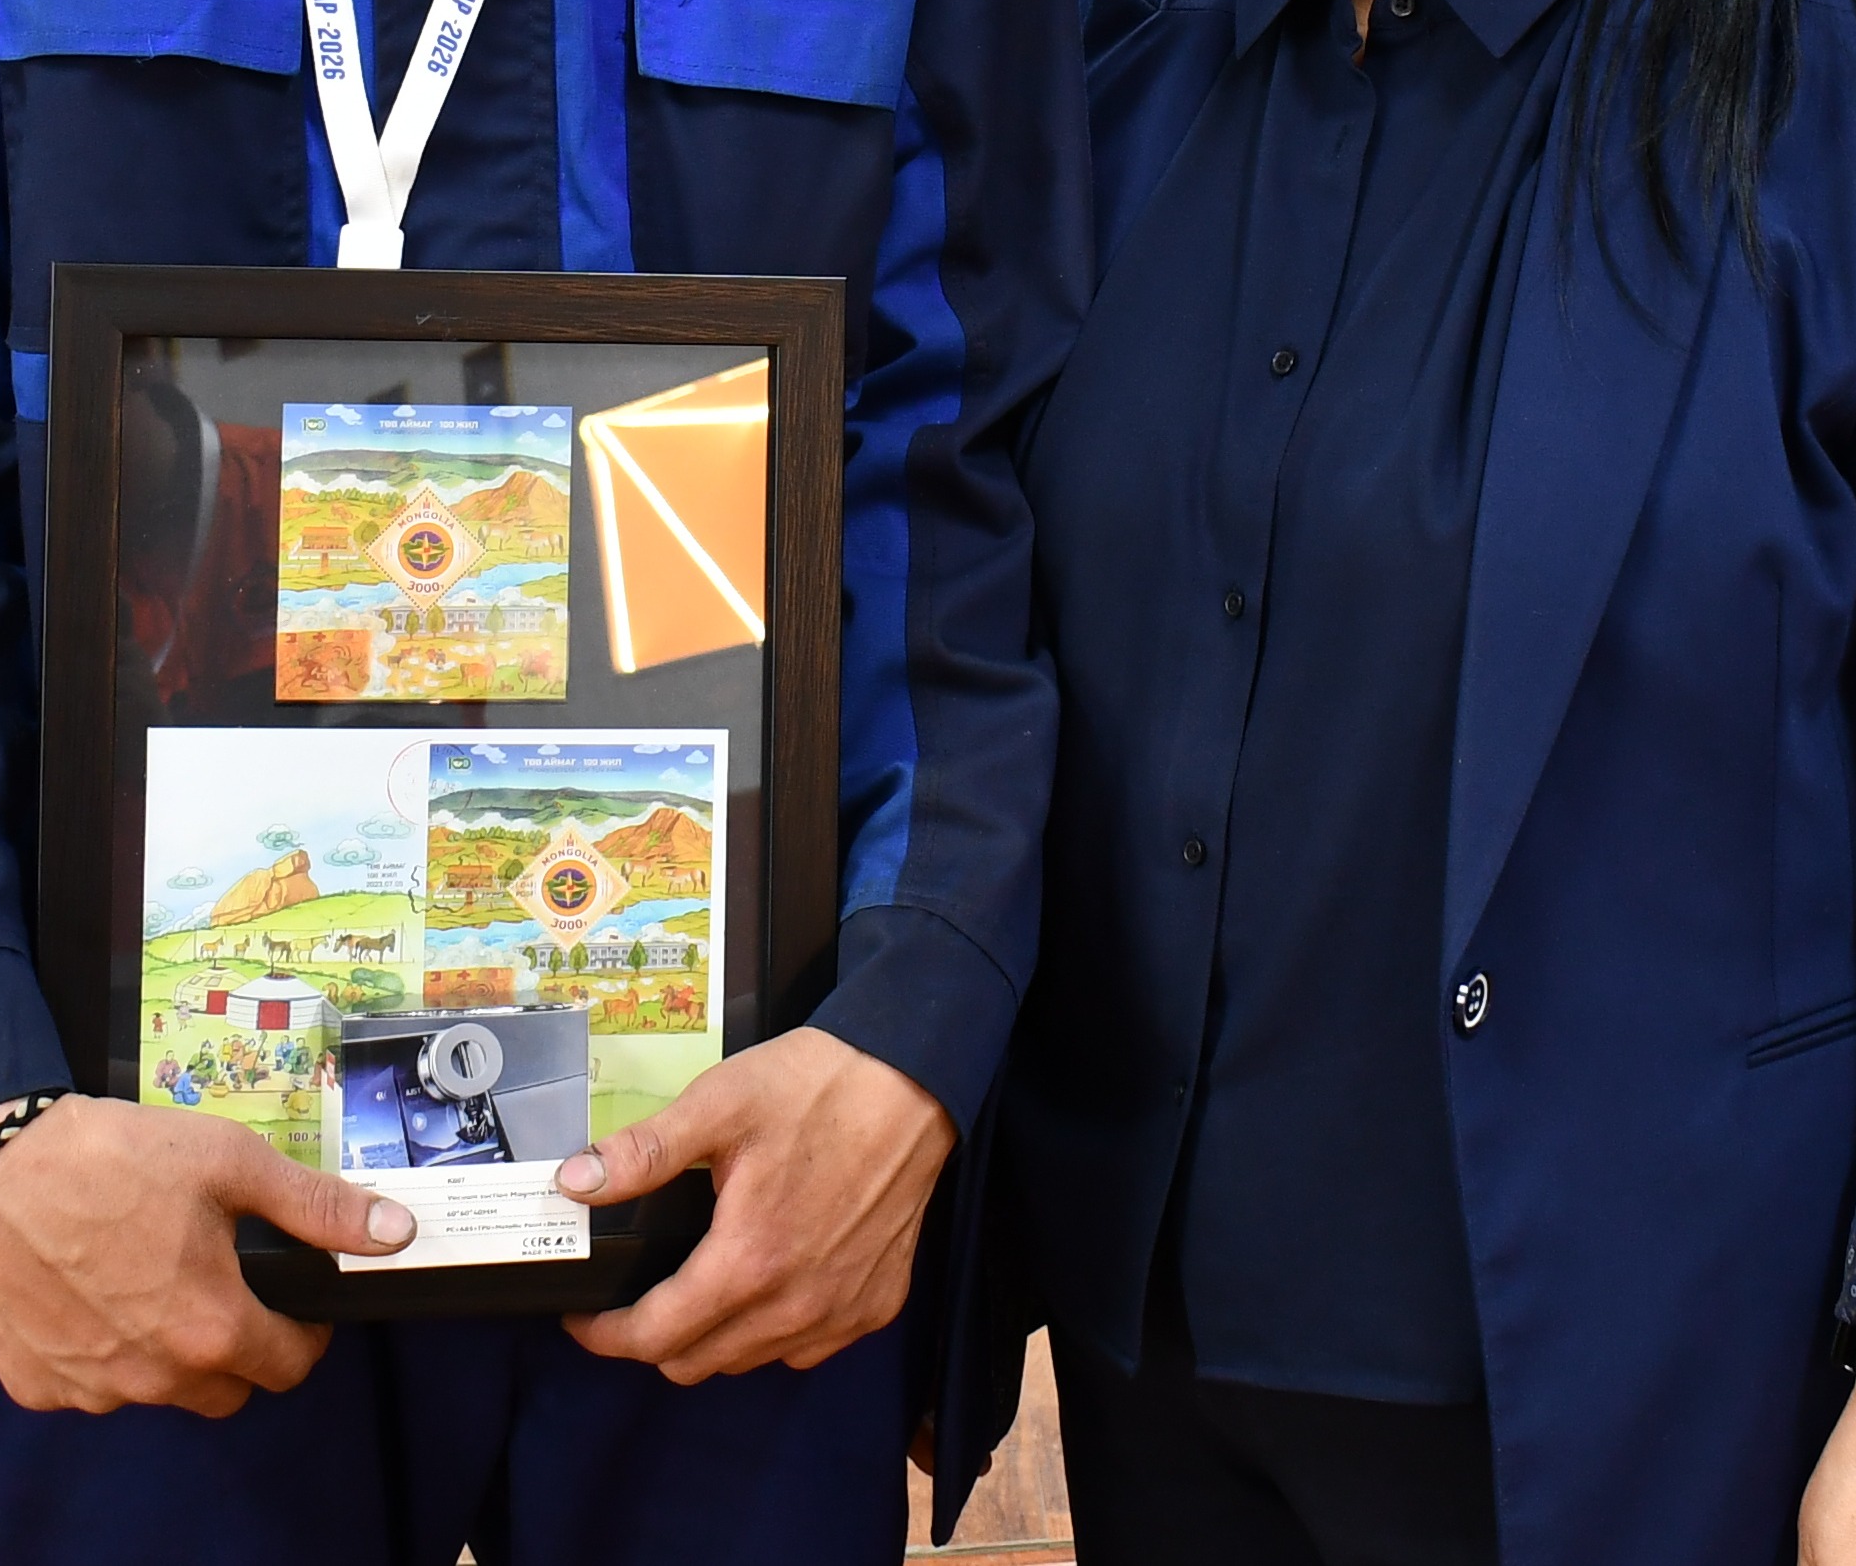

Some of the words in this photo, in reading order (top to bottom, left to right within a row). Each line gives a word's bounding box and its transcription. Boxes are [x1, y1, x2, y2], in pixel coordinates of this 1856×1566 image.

[397, 511, 455, 530] MONGOLIA
[541, 848, 599, 867] MONGOLIA
[288, 1132, 309, 1142] 100
